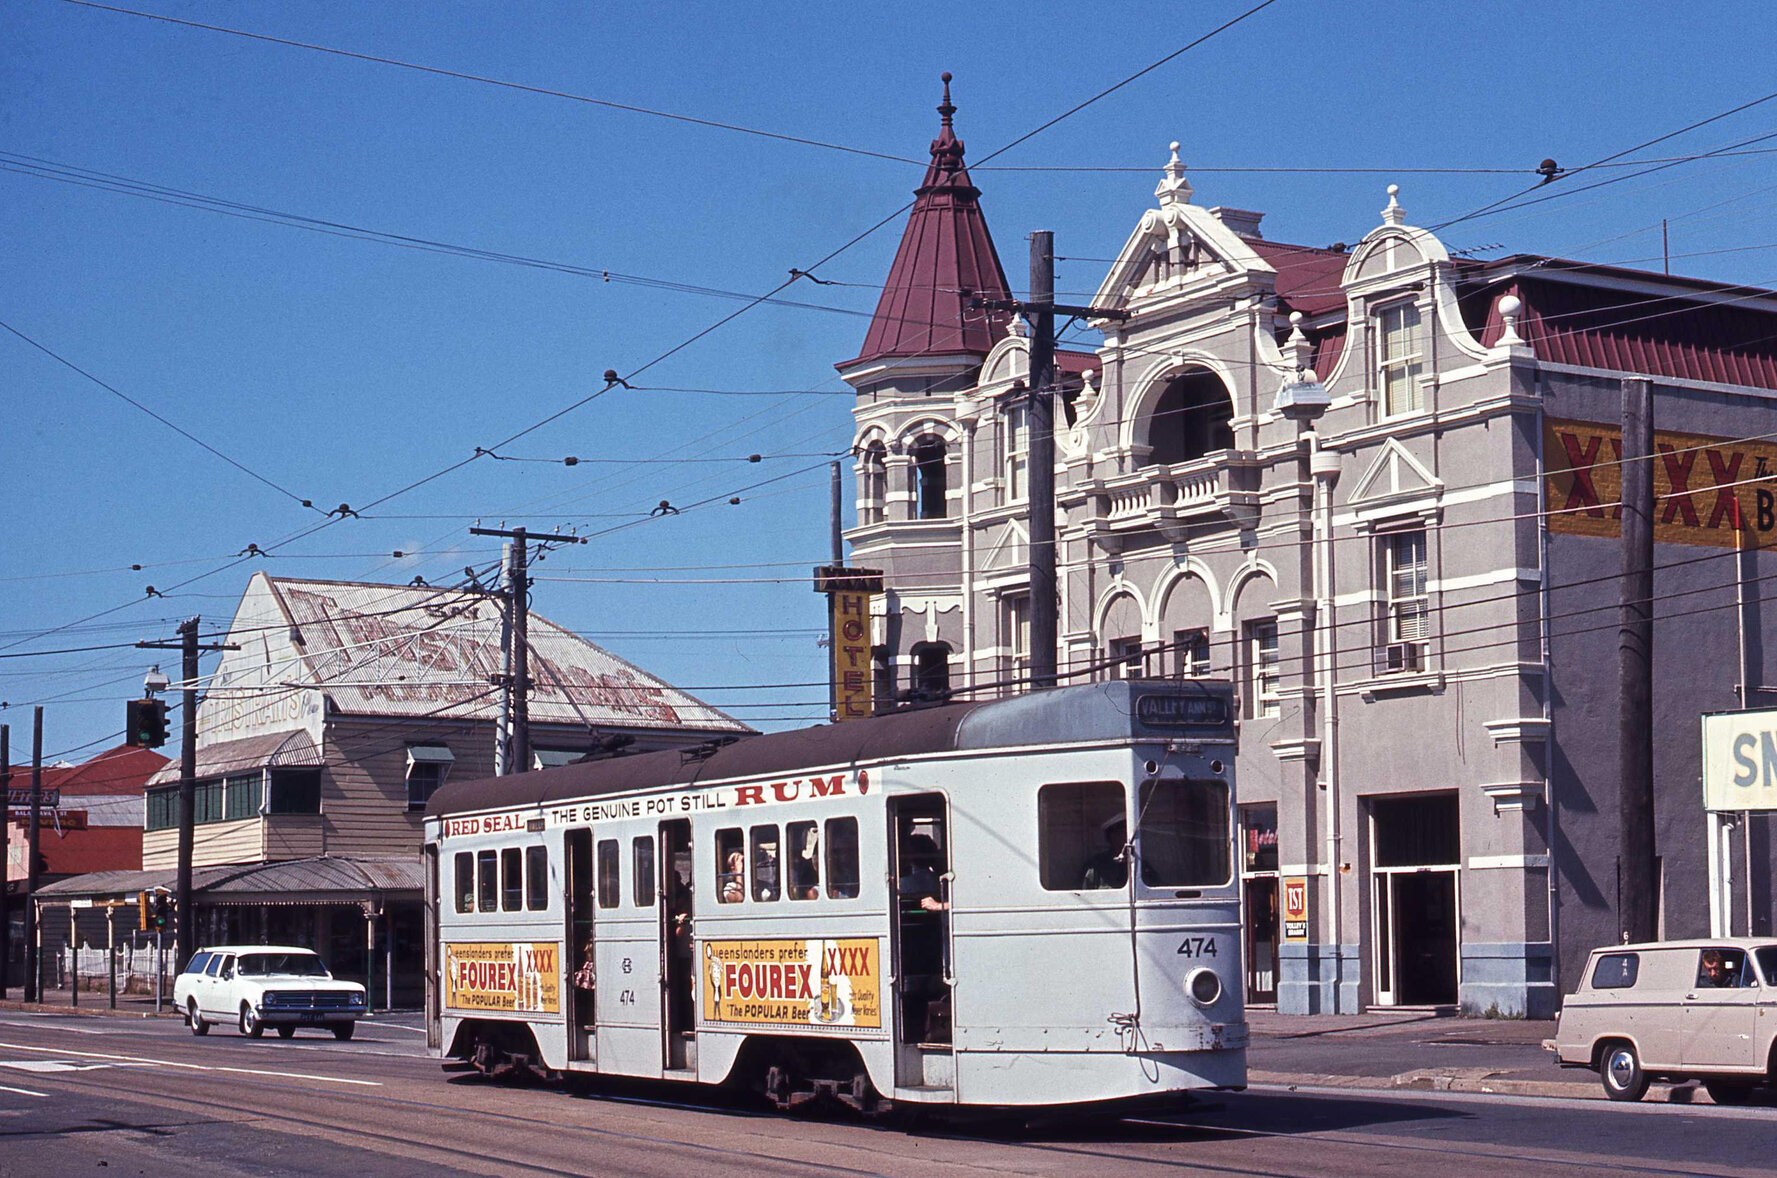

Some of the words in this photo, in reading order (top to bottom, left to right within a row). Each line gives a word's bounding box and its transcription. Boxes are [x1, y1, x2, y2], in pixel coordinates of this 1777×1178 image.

[842, 595, 864, 716] HOTEL
[451, 819, 480, 837] RED
[483, 814, 525, 833] SEAL
[552, 808, 577, 824] THE
[583, 801, 640, 820] GENUINE
[646, 797, 675, 814] POT
[681, 792, 726, 811] STILL
[734, 774, 846, 806] RUM
[706, 942, 775, 959] Queenslanders
[779, 942, 808, 962] prefer
[1177, 937, 1218, 958] 474
[526, 949, 553, 973] XXXX
[827, 947, 870, 976] XXXX
[459, 961, 517, 991] FOUREX
[725, 963, 814, 1000] FOUREX
[471, 994, 501, 1007] POPULAR
[620, 990, 635, 1005] 474
[745, 1004, 788, 1020] POPULAR
